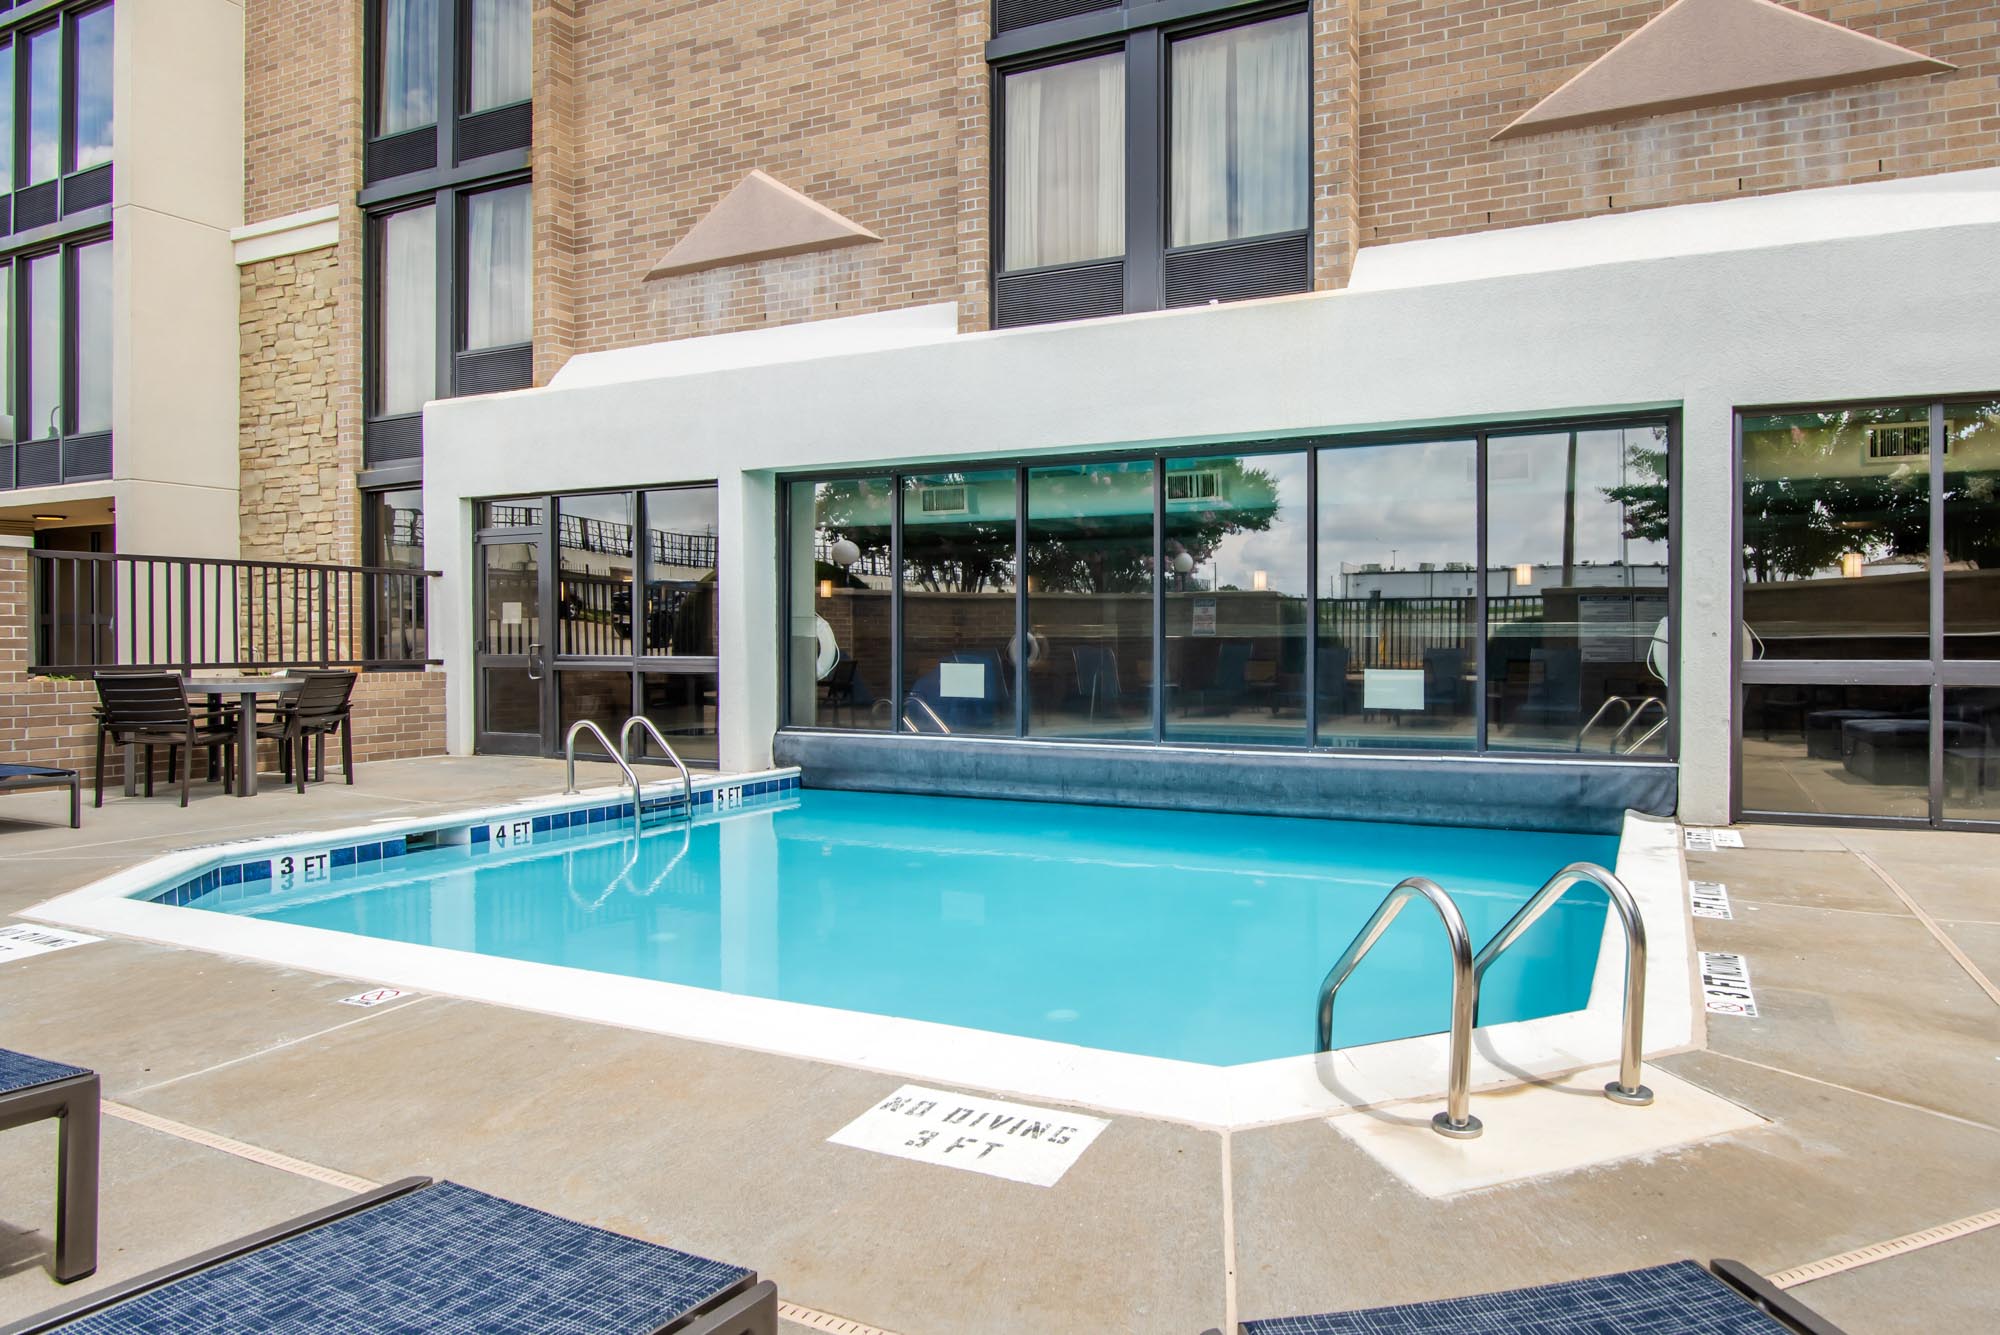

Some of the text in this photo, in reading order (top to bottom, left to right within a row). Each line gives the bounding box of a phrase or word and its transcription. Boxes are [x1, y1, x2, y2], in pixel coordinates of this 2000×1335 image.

[718, 786, 741, 801] 5 FT
[496, 821, 531, 839] 4 FT
[280, 854, 328, 875] 3 FT
[880, 1096, 1078, 1145] NO DIVING
[904, 1129, 1005, 1159] 3 FT
